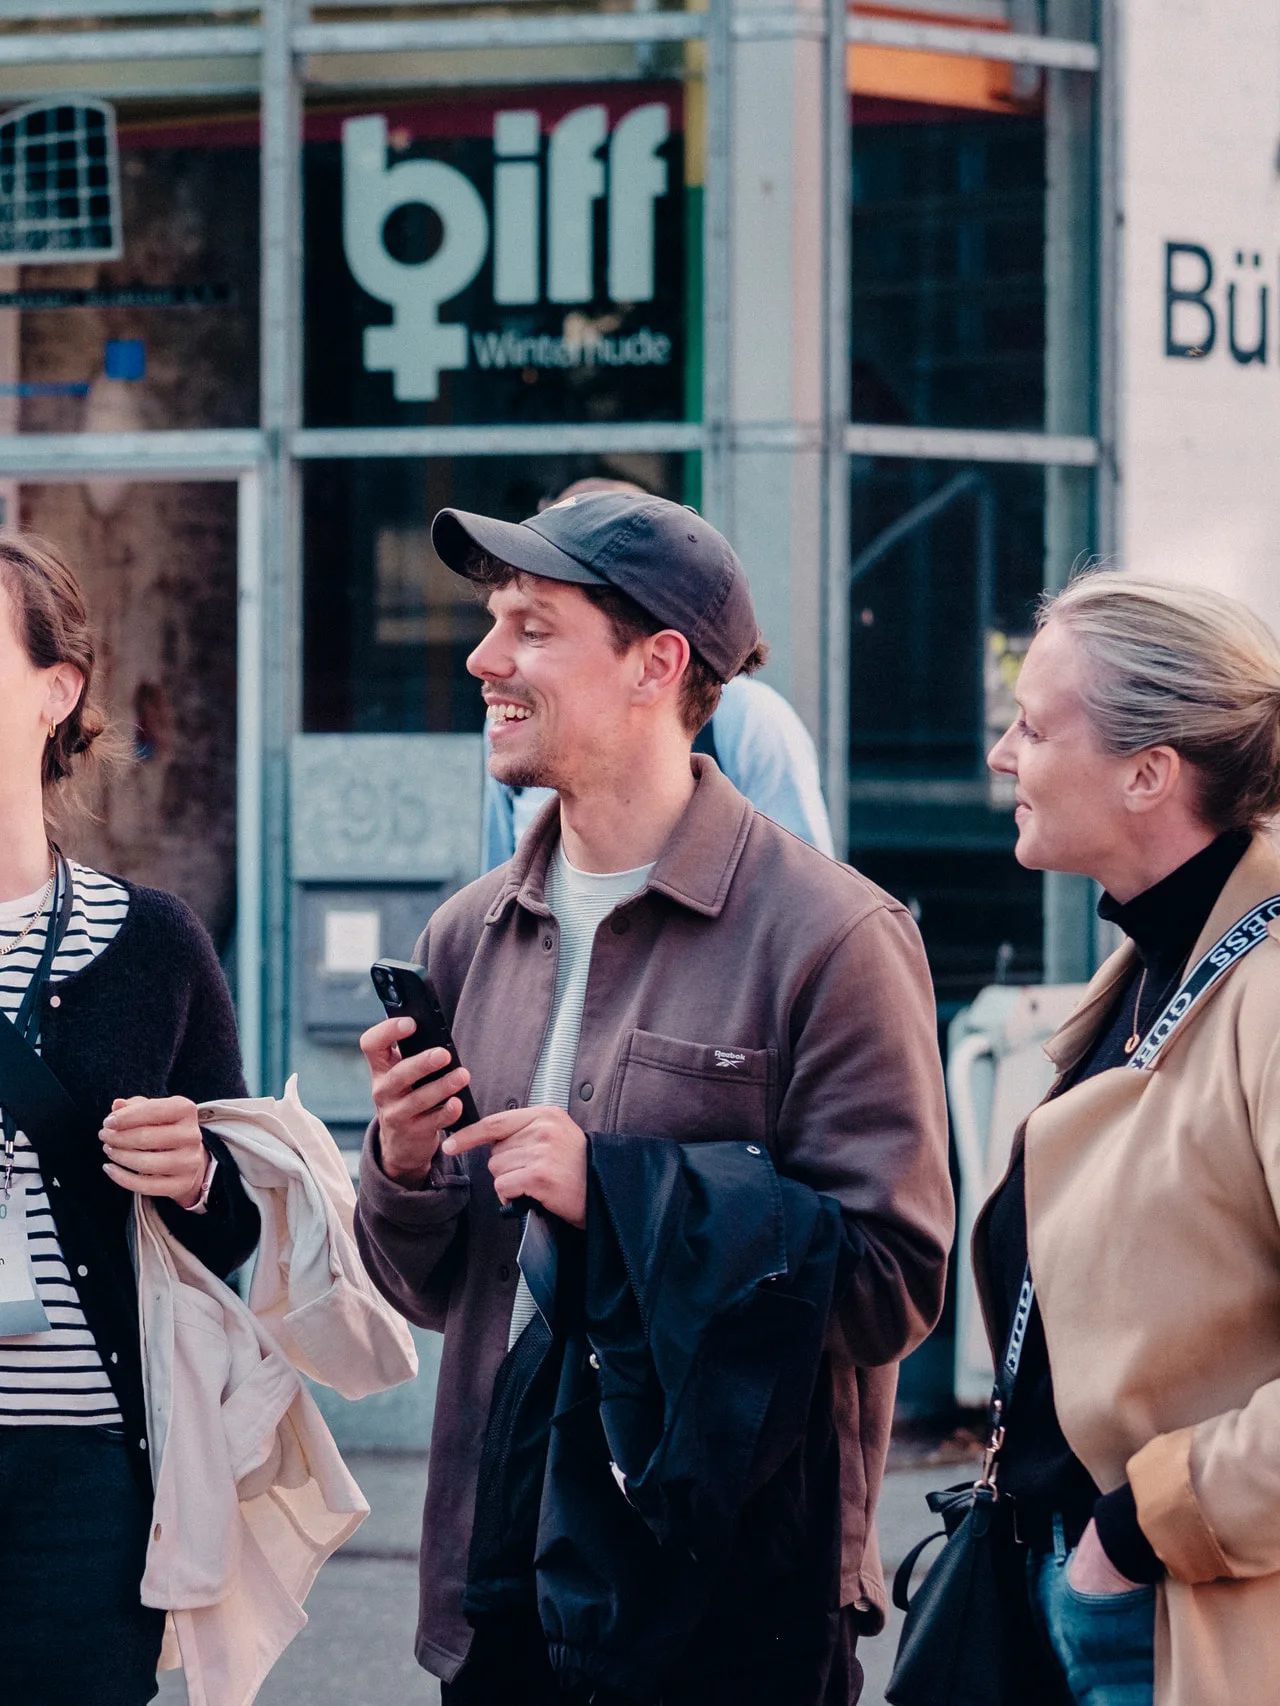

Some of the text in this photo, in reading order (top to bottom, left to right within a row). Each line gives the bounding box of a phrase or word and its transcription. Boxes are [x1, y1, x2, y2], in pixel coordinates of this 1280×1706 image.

[342, 103, 670, 400] biff
[1165, 241, 1280, 365] Bü
[472, 328, 671, 369] Winterhude
[715, 1050, 746, 1060] Reebok
